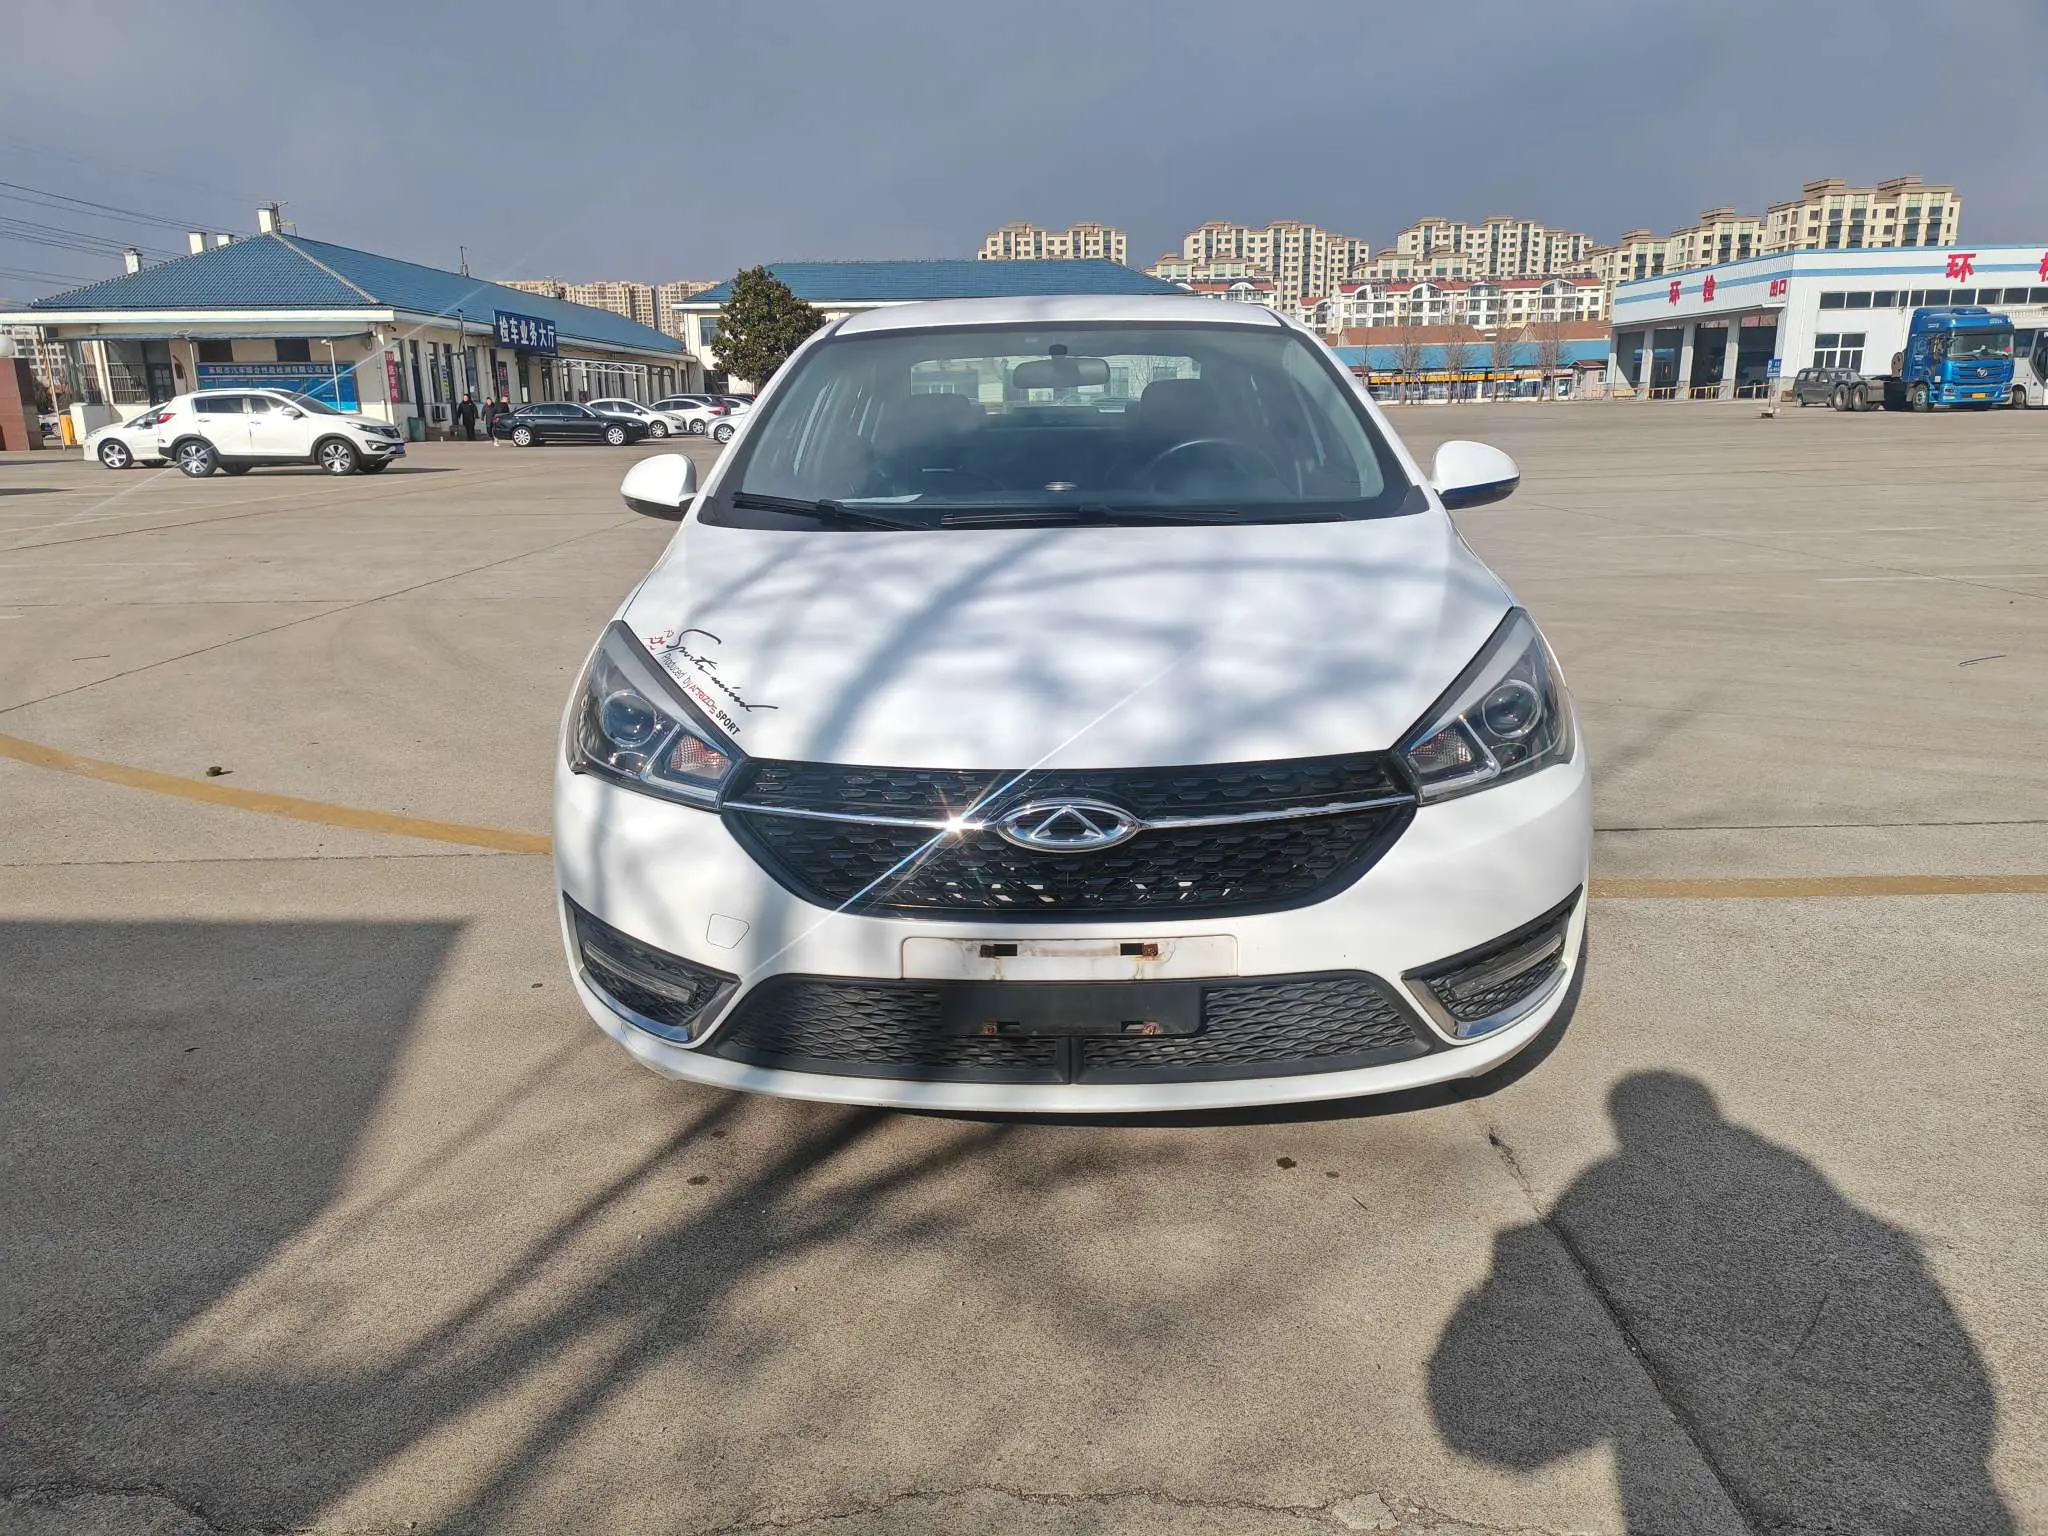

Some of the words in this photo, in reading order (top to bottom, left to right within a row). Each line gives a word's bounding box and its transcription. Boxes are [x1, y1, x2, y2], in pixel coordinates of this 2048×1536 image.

[499, 315, 555, 348] 检车业务大厅
[662, 653, 686, 680] Produced
[715, 709, 741, 735] SPORT
